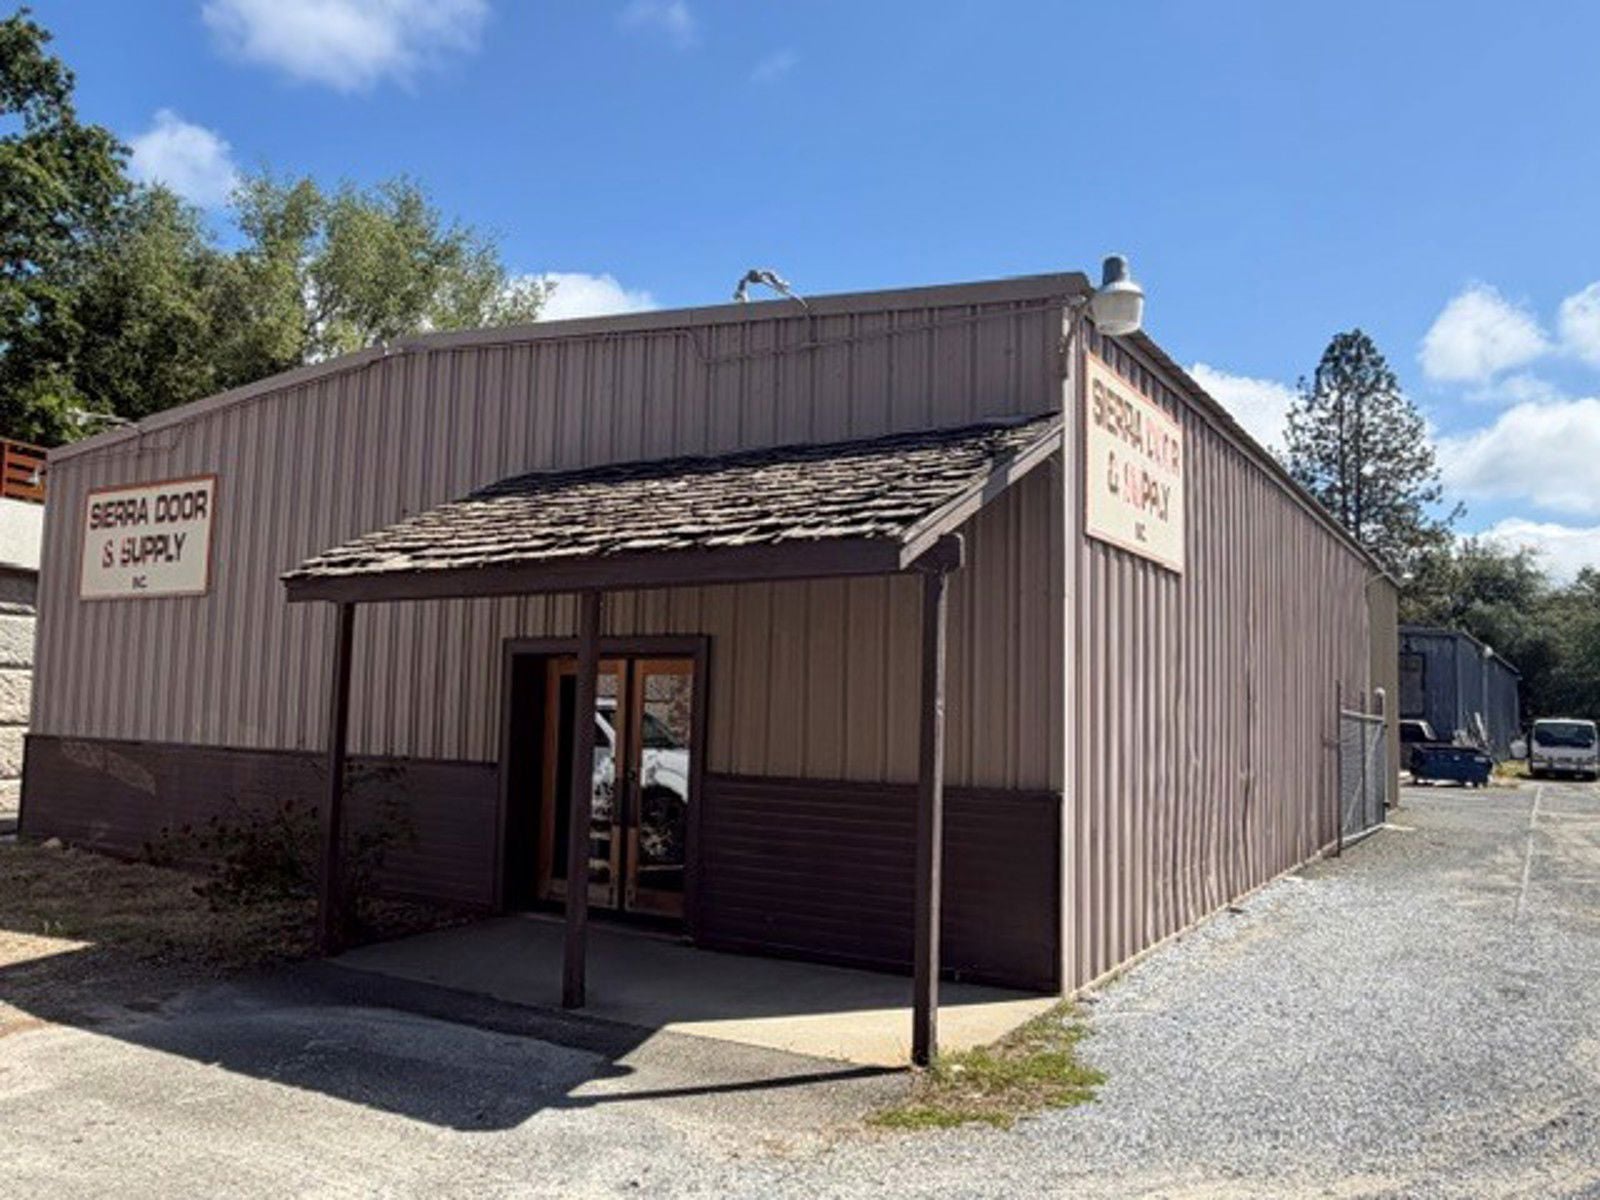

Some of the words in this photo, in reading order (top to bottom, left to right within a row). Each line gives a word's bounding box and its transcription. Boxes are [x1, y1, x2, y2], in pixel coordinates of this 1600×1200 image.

[89, 497, 149, 530] SIERRA
[154, 489, 208, 523] DOOR
[120, 532, 187, 568] SUPPLY
